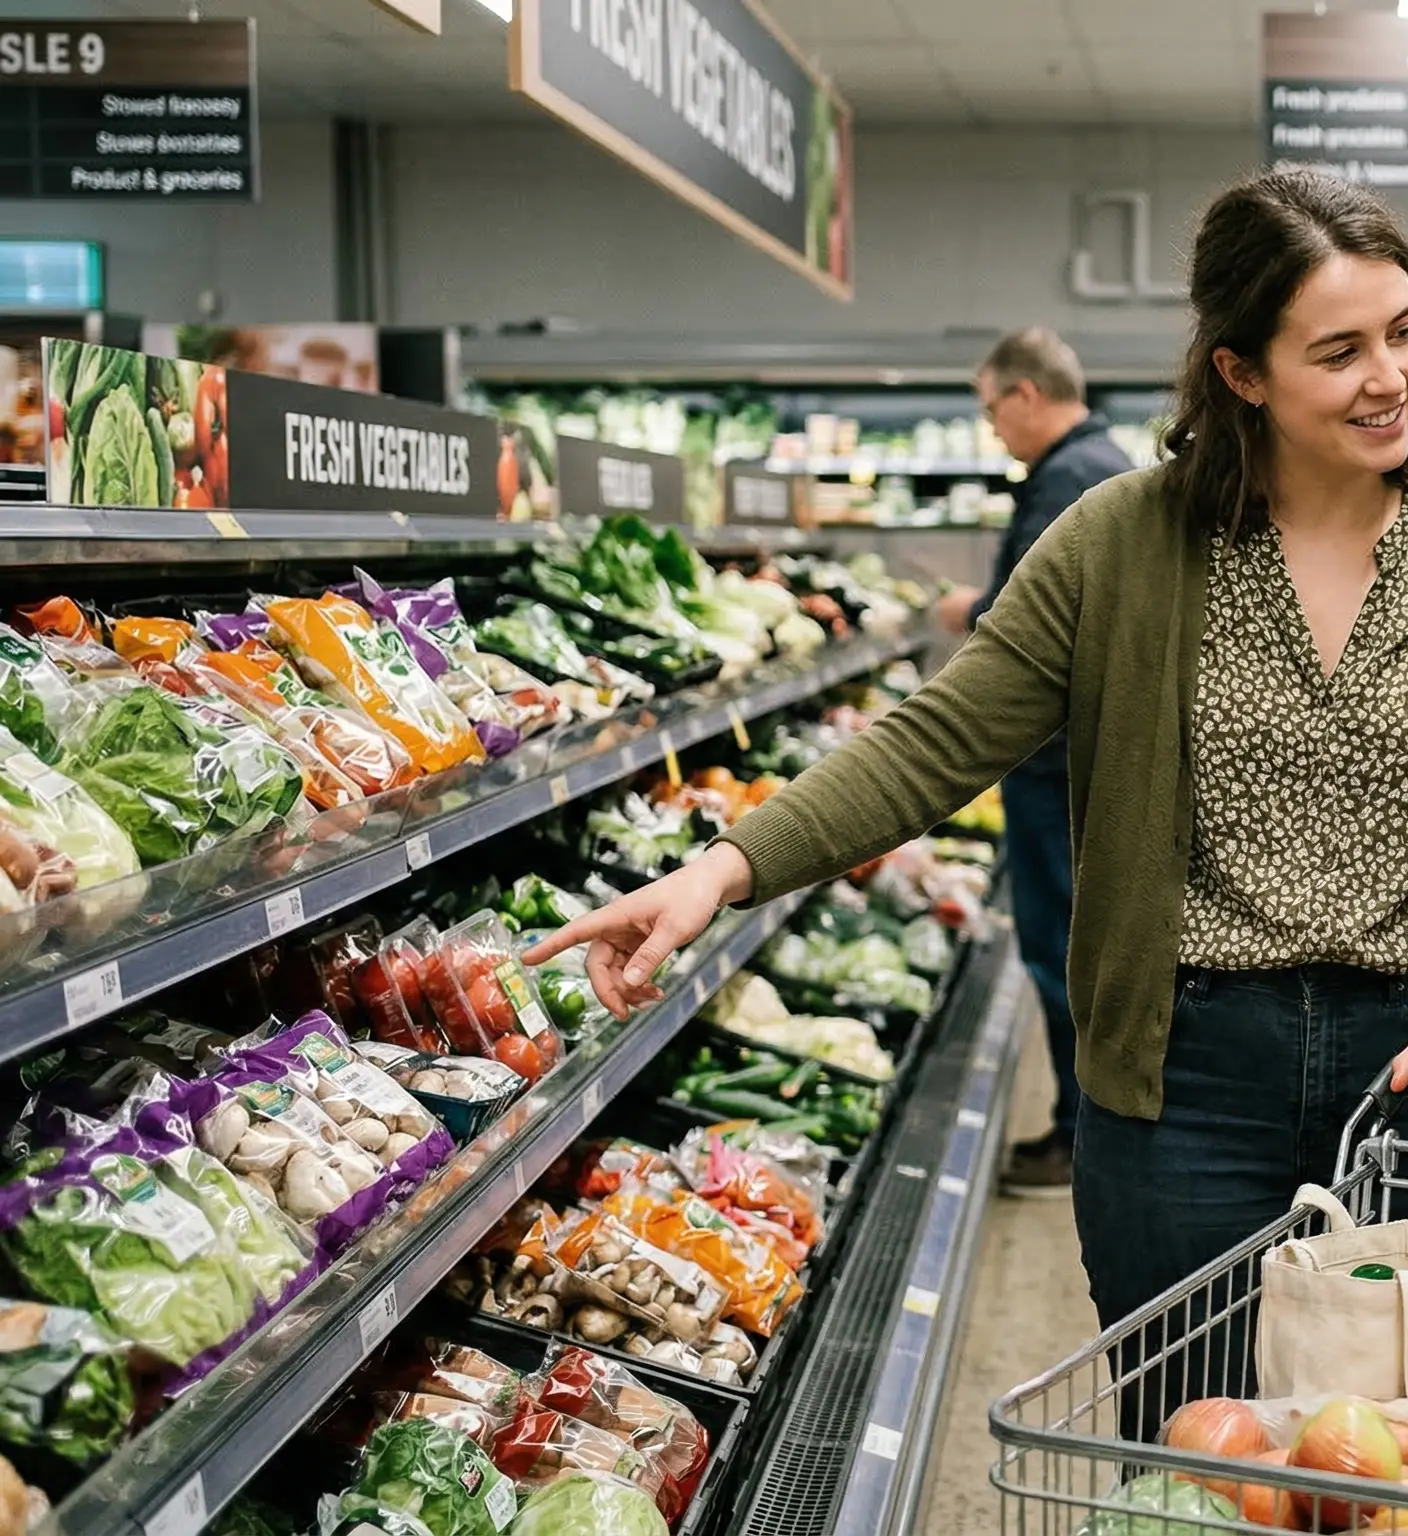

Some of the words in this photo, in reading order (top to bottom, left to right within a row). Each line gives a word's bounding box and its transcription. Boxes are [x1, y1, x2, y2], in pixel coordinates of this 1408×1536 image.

[78, 33, 104, 74] 9
[667, 0, 796, 200] VEGETABLES
[285, 412, 355, 485] FRESH
[359, 422, 470, 495] VEGETABLES
